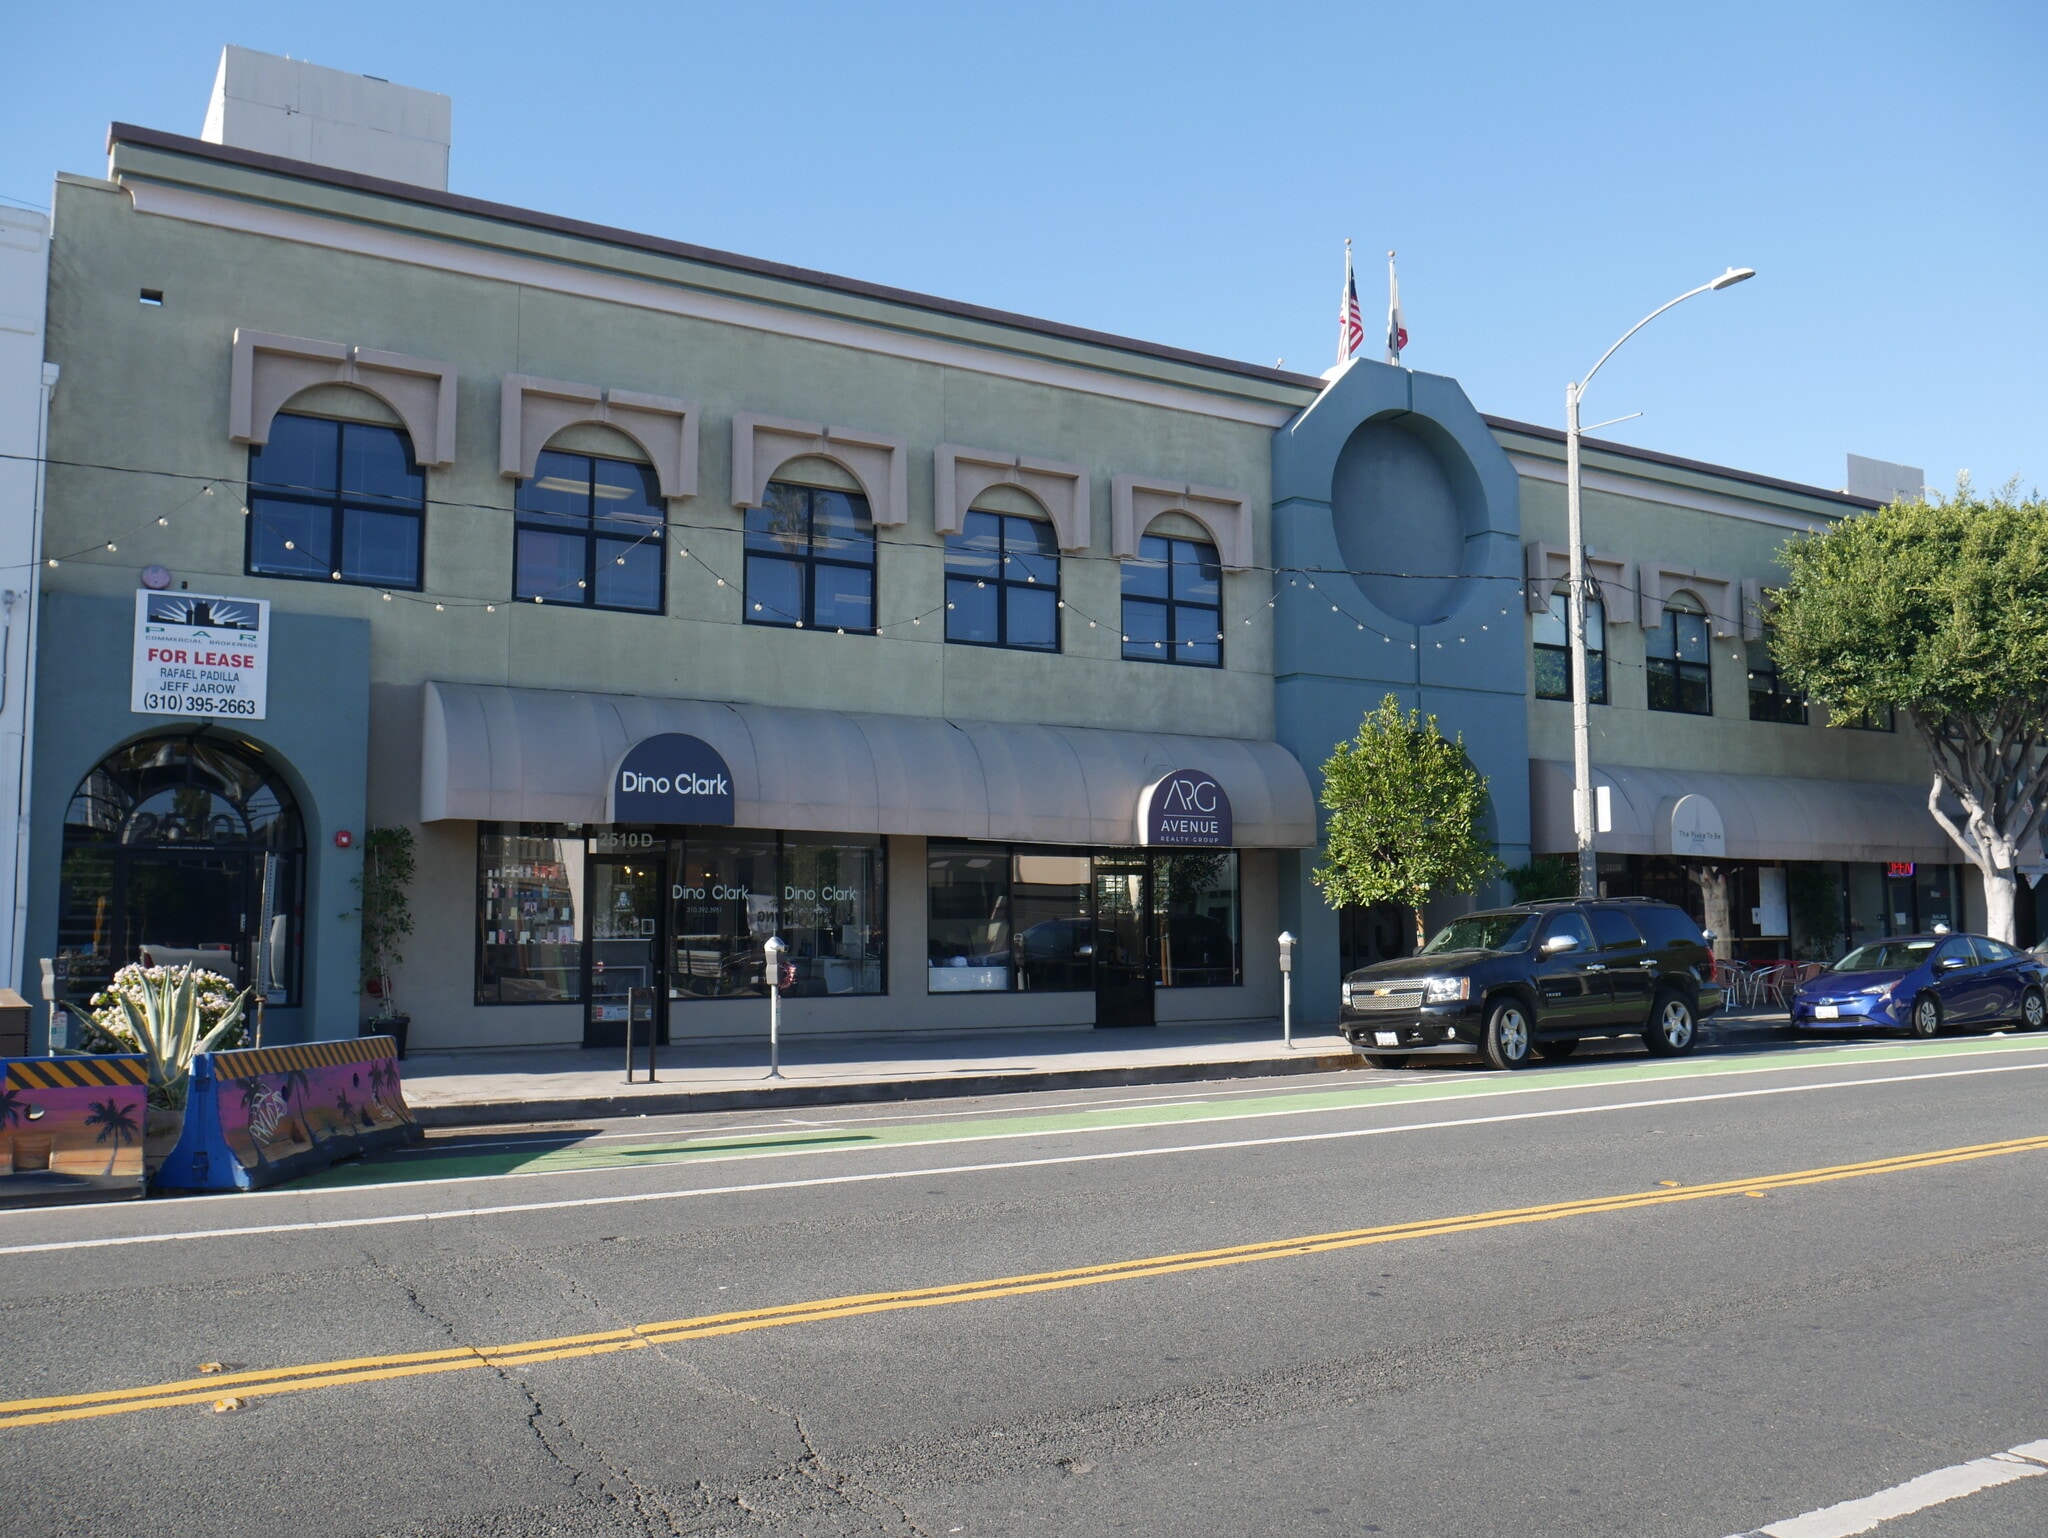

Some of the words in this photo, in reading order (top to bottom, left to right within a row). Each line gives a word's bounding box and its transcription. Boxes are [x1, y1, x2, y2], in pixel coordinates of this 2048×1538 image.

[145, 635, 202, 644] COMMERCIAL
[209, 640, 259, 648] BROKERAGE
[147, 648, 187, 664] FOR
[194, 651, 254, 669] LEASE
[160, 667, 197, 680] RAFAEL
[200, 670, 240, 682] PADILLA
[160, 681, 189, 692] JEFF
[192, 683, 236, 694] JAROW
[144, 692, 183, 712] (310)
[186, 696, 255, 715] 395-2663
[622, 771, 670, 794] Dino
[675, 772, 728, 795] Clark
[1163, 779, 1216, 812] ARG
[1160, 819, 1219, 834] AVENUE
[1678, 830, 1690, 838] The
[672, 884, 706, 900] Dino
[712, 884, 750, 900] Clark
[784, 885, 816, 901] Dino
[822, 885, 857, 901] Clark
